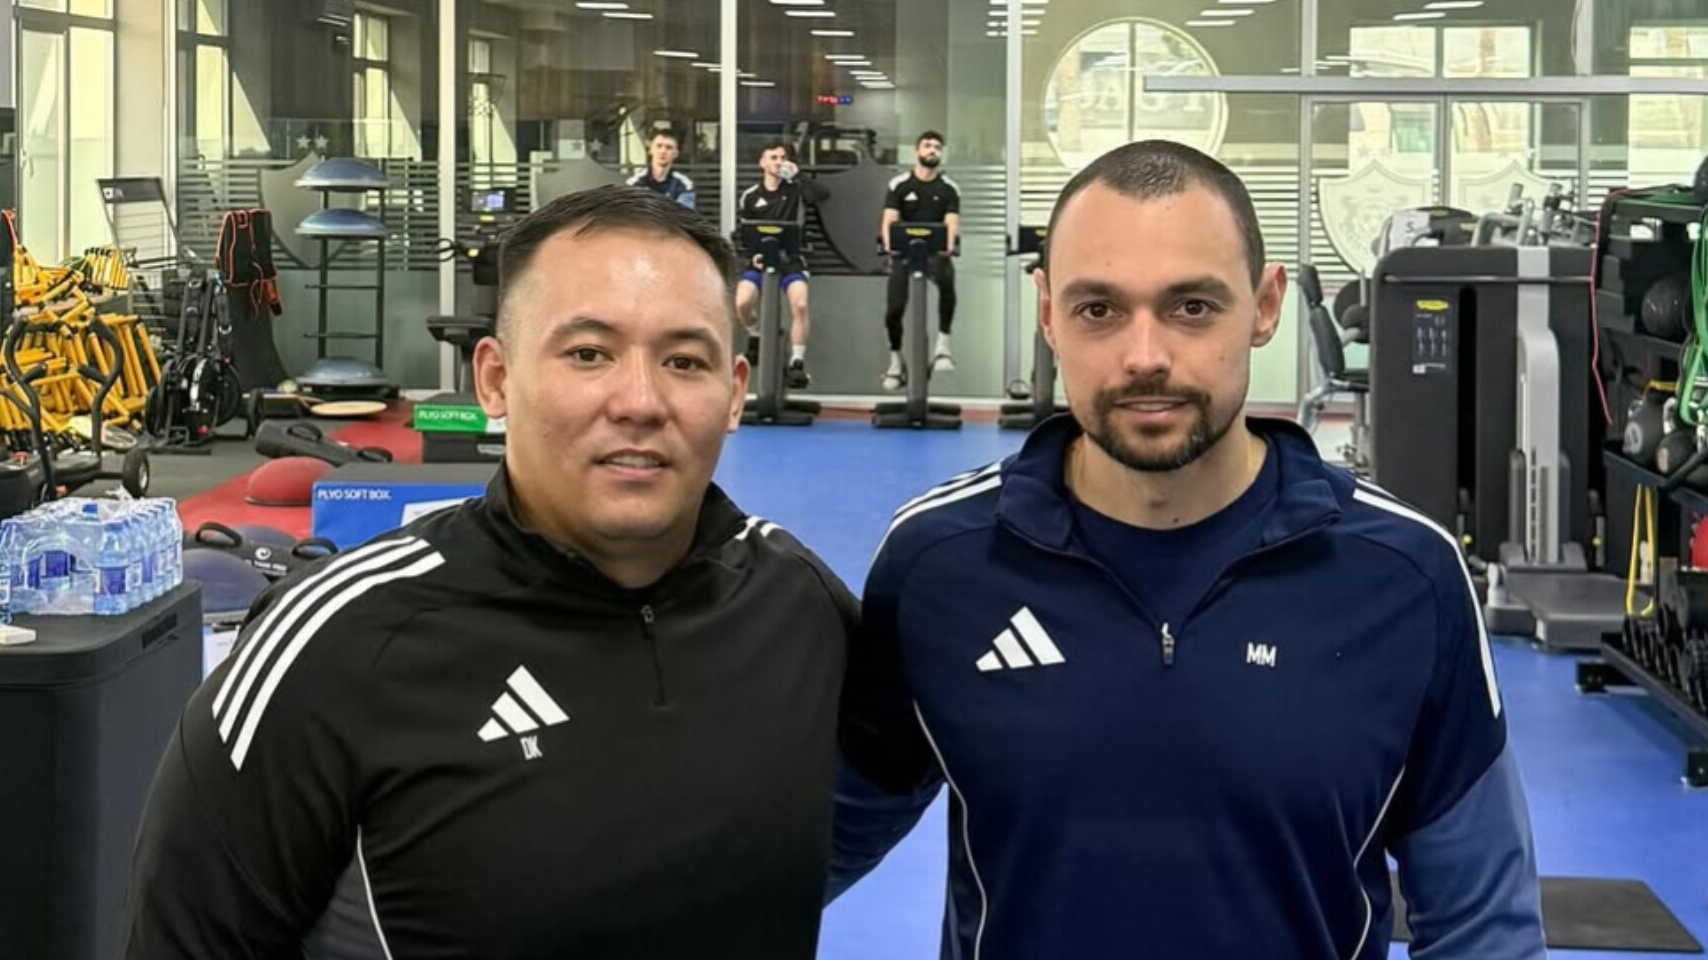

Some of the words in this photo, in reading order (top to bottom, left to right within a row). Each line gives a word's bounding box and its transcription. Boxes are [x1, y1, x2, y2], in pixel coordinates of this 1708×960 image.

[318, 489, 343, 500] PLYO
[344, 489, 368, 500] SOFT
[1246, 641, 1278, 668] MM
[520, 735, 543, 760] DK
